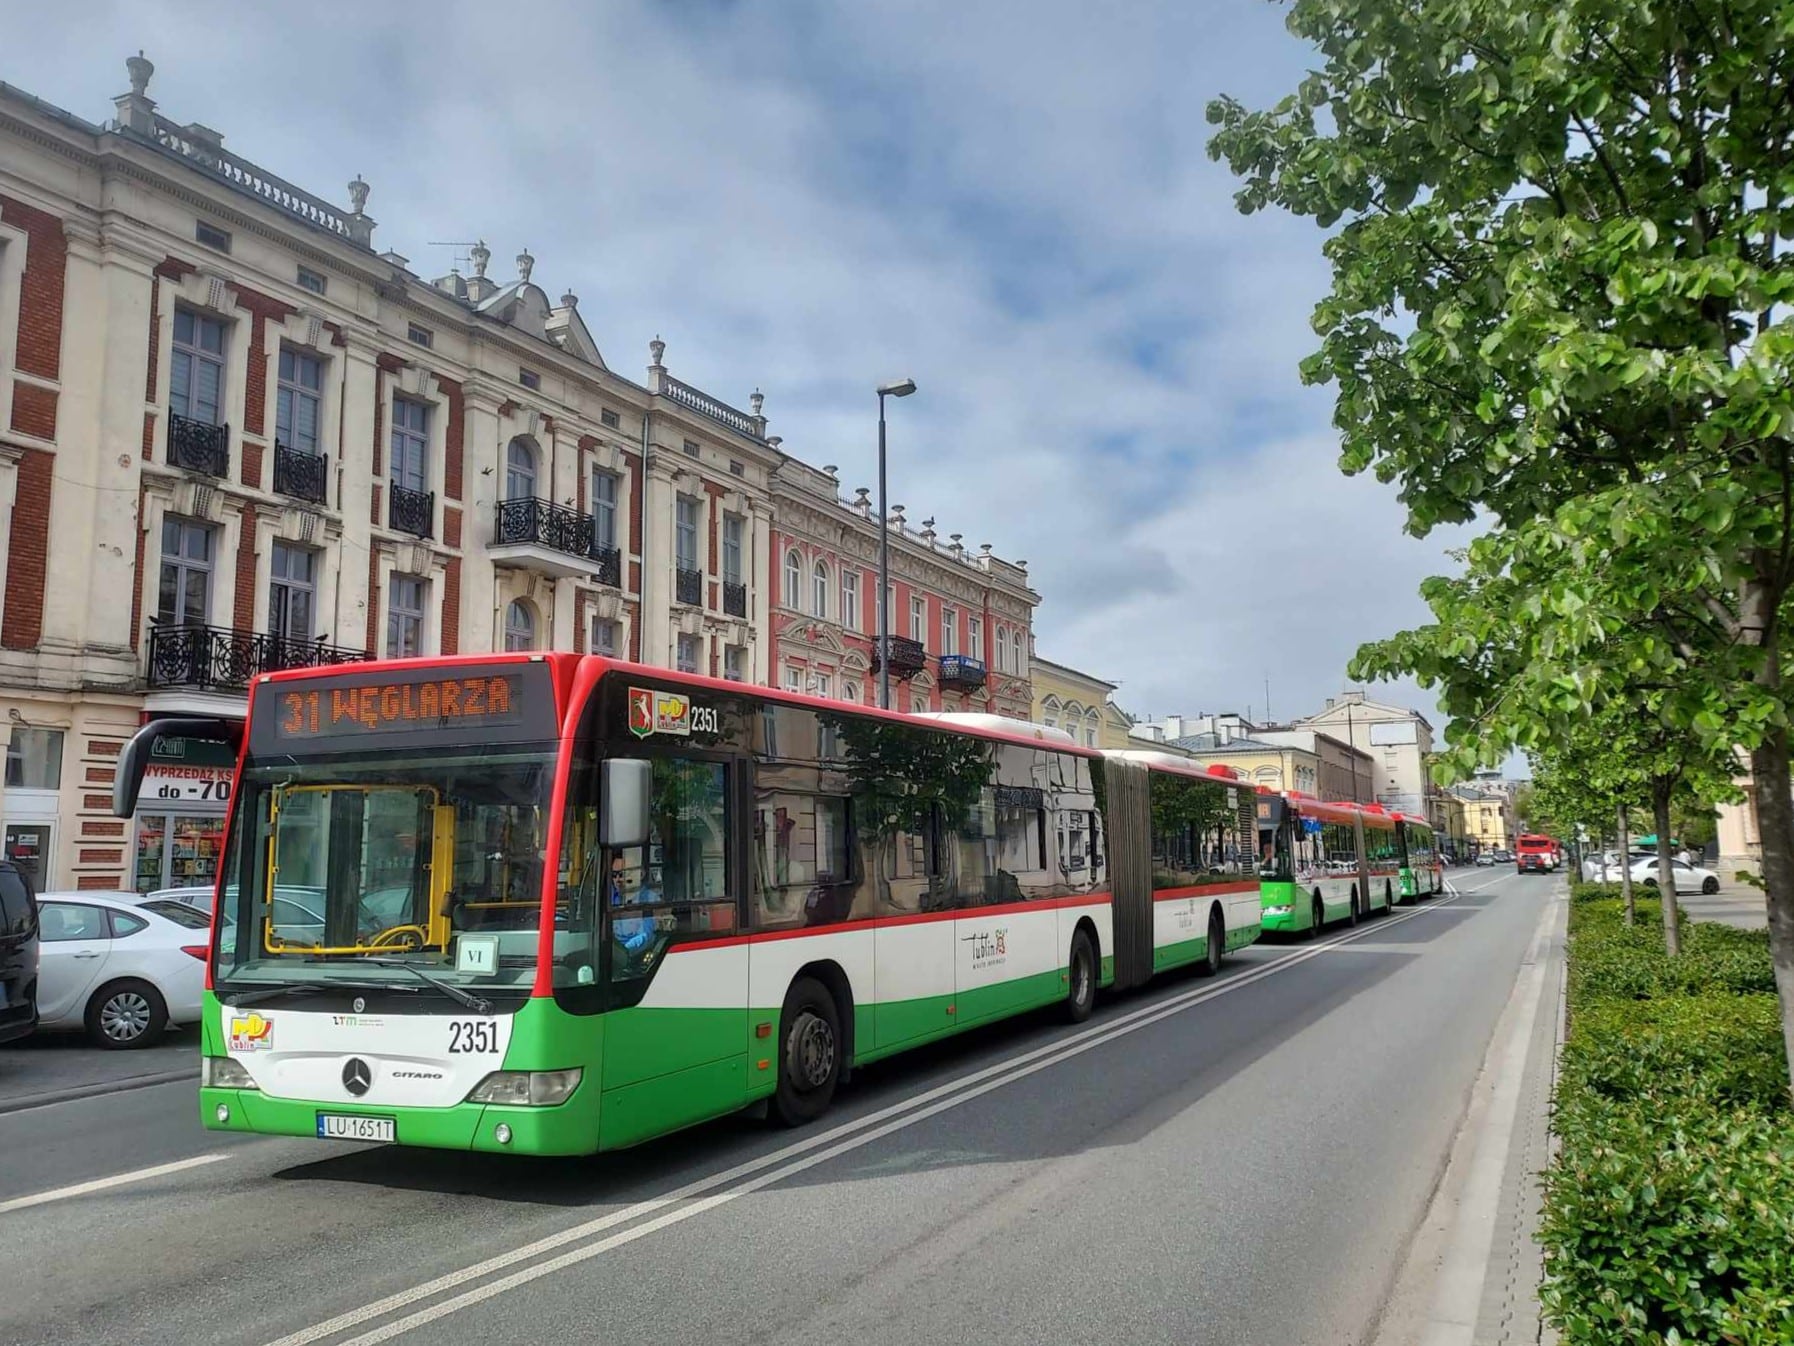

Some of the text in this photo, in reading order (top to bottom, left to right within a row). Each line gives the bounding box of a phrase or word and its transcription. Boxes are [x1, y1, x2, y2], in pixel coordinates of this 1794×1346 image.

[284, 677, 509, 733] 31 WĘGLARZA
[691, 706, 718, 733] 2351
[158, 780, 231, 800] do -70
[468, 950, 482, 963] VI
[448, 1021, 499, 1053] 2351
[392, 1071, 443, 1079] CITARO
[327, 1117, 392, 1138] LU 1651T
